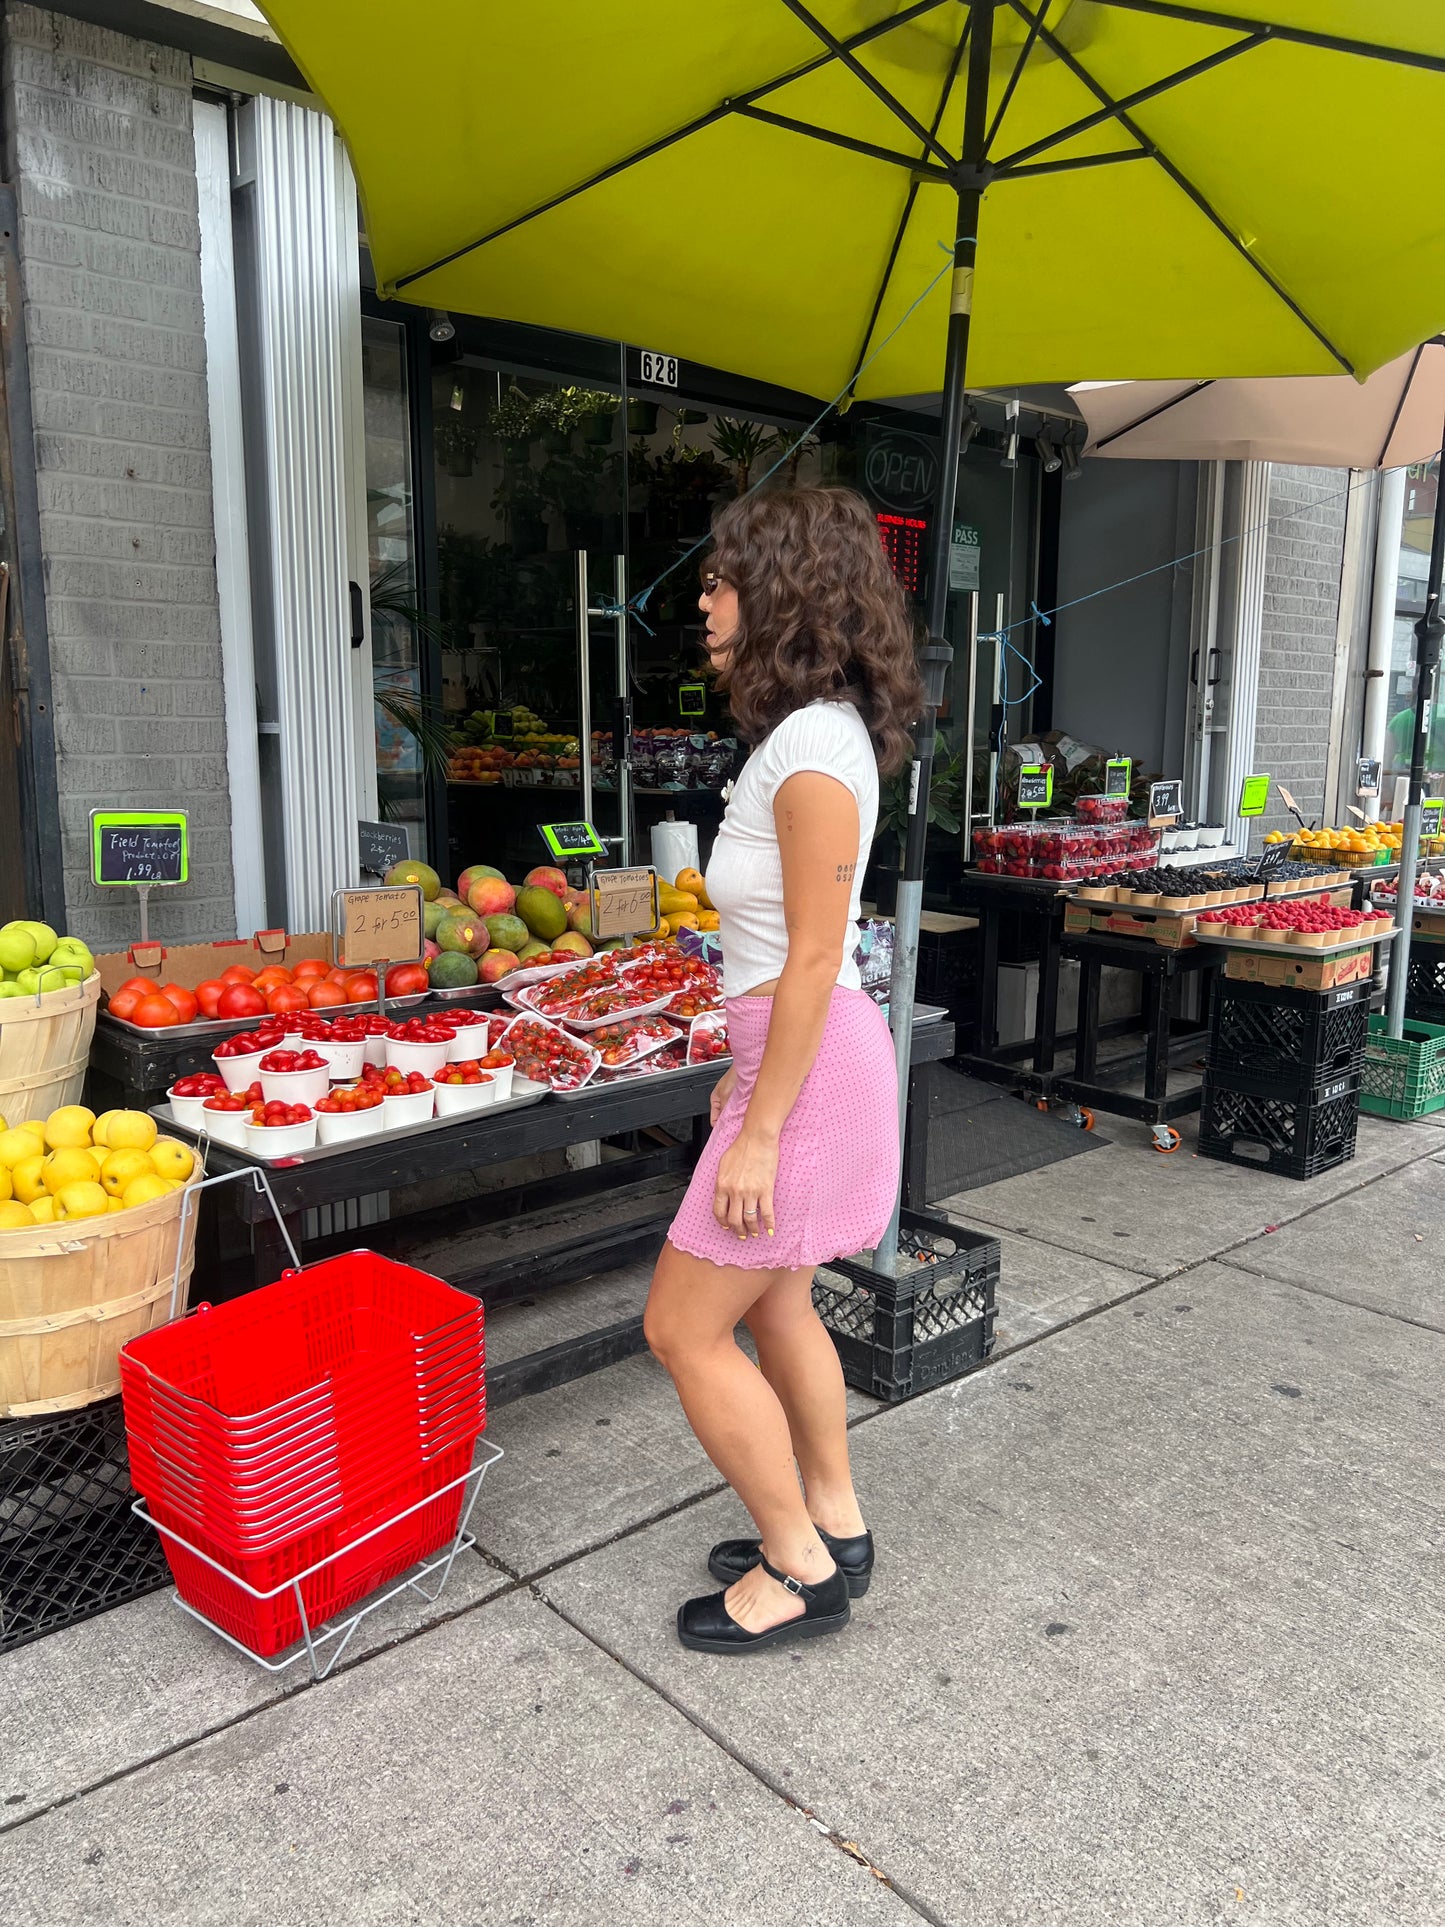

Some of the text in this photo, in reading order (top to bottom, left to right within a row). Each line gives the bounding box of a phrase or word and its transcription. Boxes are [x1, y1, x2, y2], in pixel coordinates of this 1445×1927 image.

[643, 353, 676, 385] 628
[869, 450, 933, 494] OPEN
[877, 513, 927, 529] BUSINESS HOURS
[955, 528, 978, 545] PASS
[110, 833, 139, 850] Field
[126, 863, 152, 880] 1.99
[620, 874, 649, 885] Tomatoes
[347, 892, 407, 905] Grape Tomato
[603, 893, 614, 914] 2
[616, 899, 629, 917] for
[354, 914, 367, 934] 2
[372, 917, 388, 934] for
